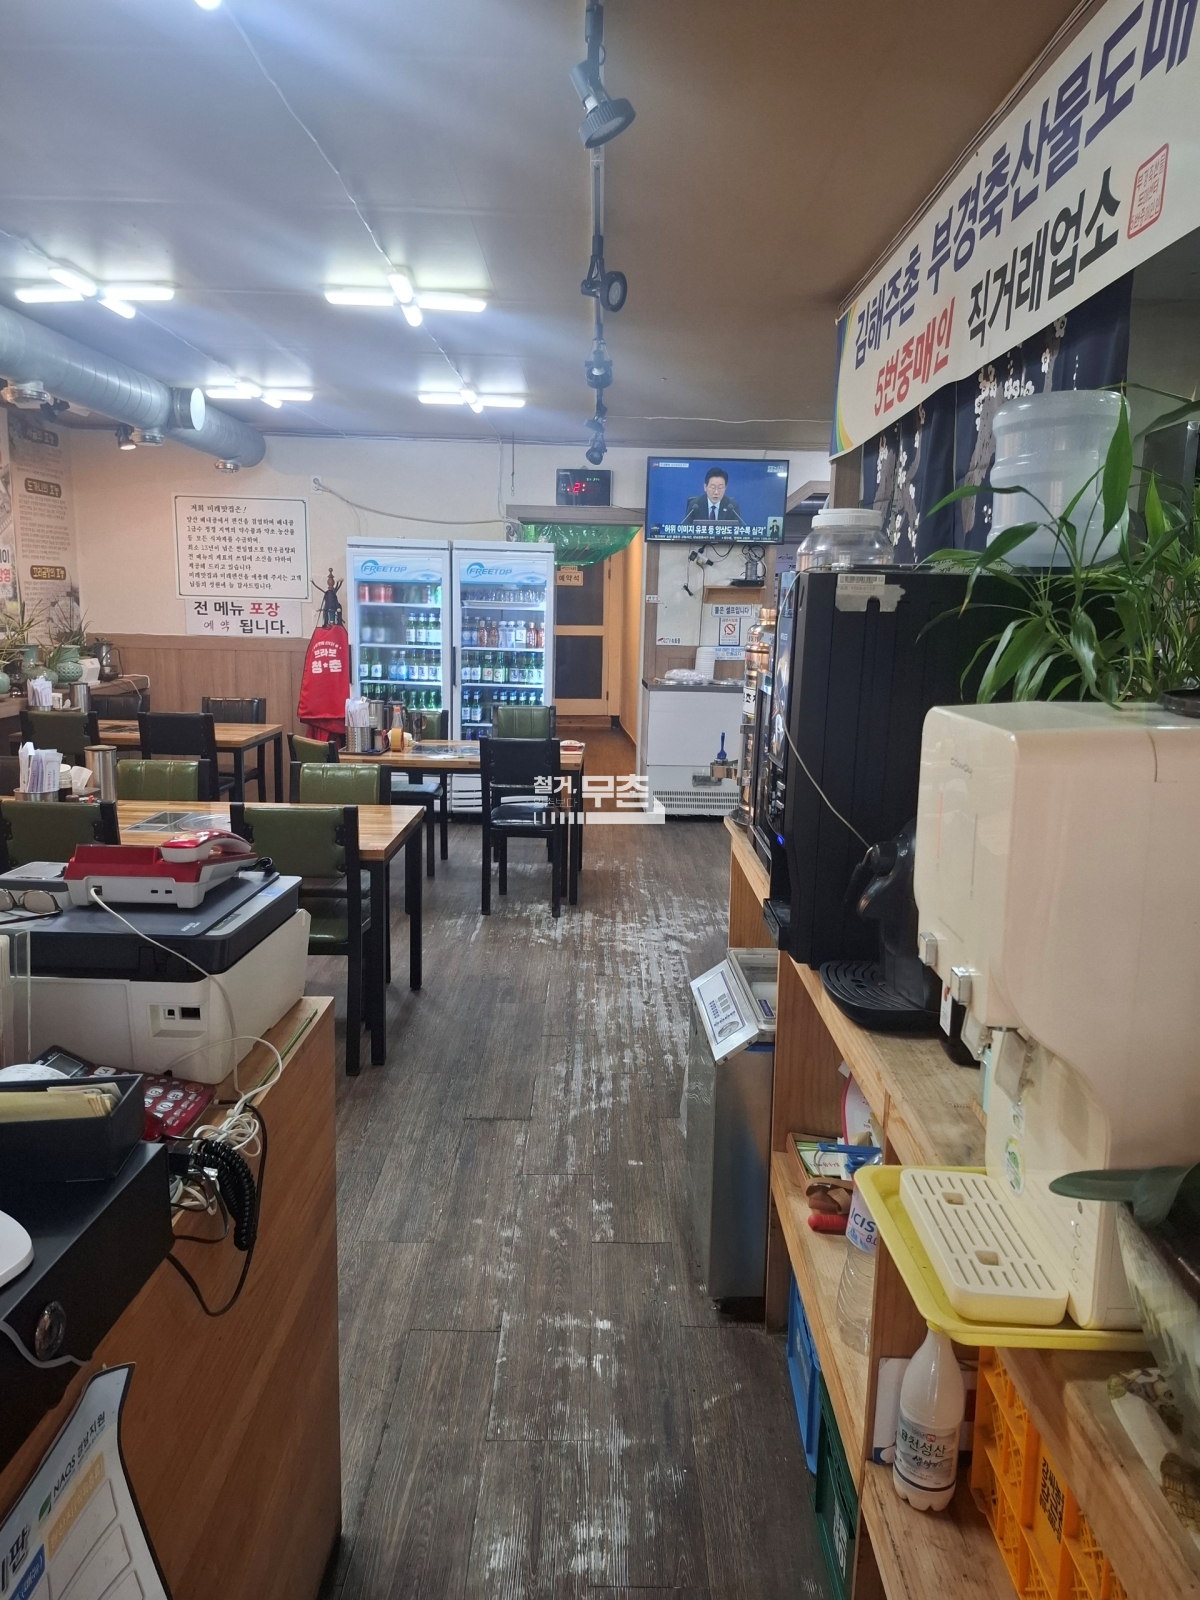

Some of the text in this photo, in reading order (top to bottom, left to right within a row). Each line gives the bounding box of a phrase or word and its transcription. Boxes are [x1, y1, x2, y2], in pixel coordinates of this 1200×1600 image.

[874, 166, 1121, 416] 5번중매인 직거래업소
[855, 244, 922, 370] 김해주촌
[191, 504, 247, 514] 저희 미래맛집은!
[677, 525, 694, 534] 이미지
[695, 525, 707, 535] 유포
[708, 525, 715, 535] 등
[715, 526, 733, 535] 양상도
[734, 526, 751, 536] 갈수록
[187, 534, 193, 542] 등
[195, 535, 208, 543] 모든
[363, 564, 408, 573] FREETOP
[469, 567, 513, 576] FREETOP
[558, 574, 580, 582] 예약석
[194, 601, 280, 618] 전 메뉴 포장
[726, 606, 750, 615] 셀프입니다
[239, 619, 290, 635] 됩니다.
[314, 648, 337, 659] 브라보
[77, 1411, 106, 1458] 경남지원
[907, 1436, 947, 1458] 천성산
[53, 1454, 76, 1497] NAQS
